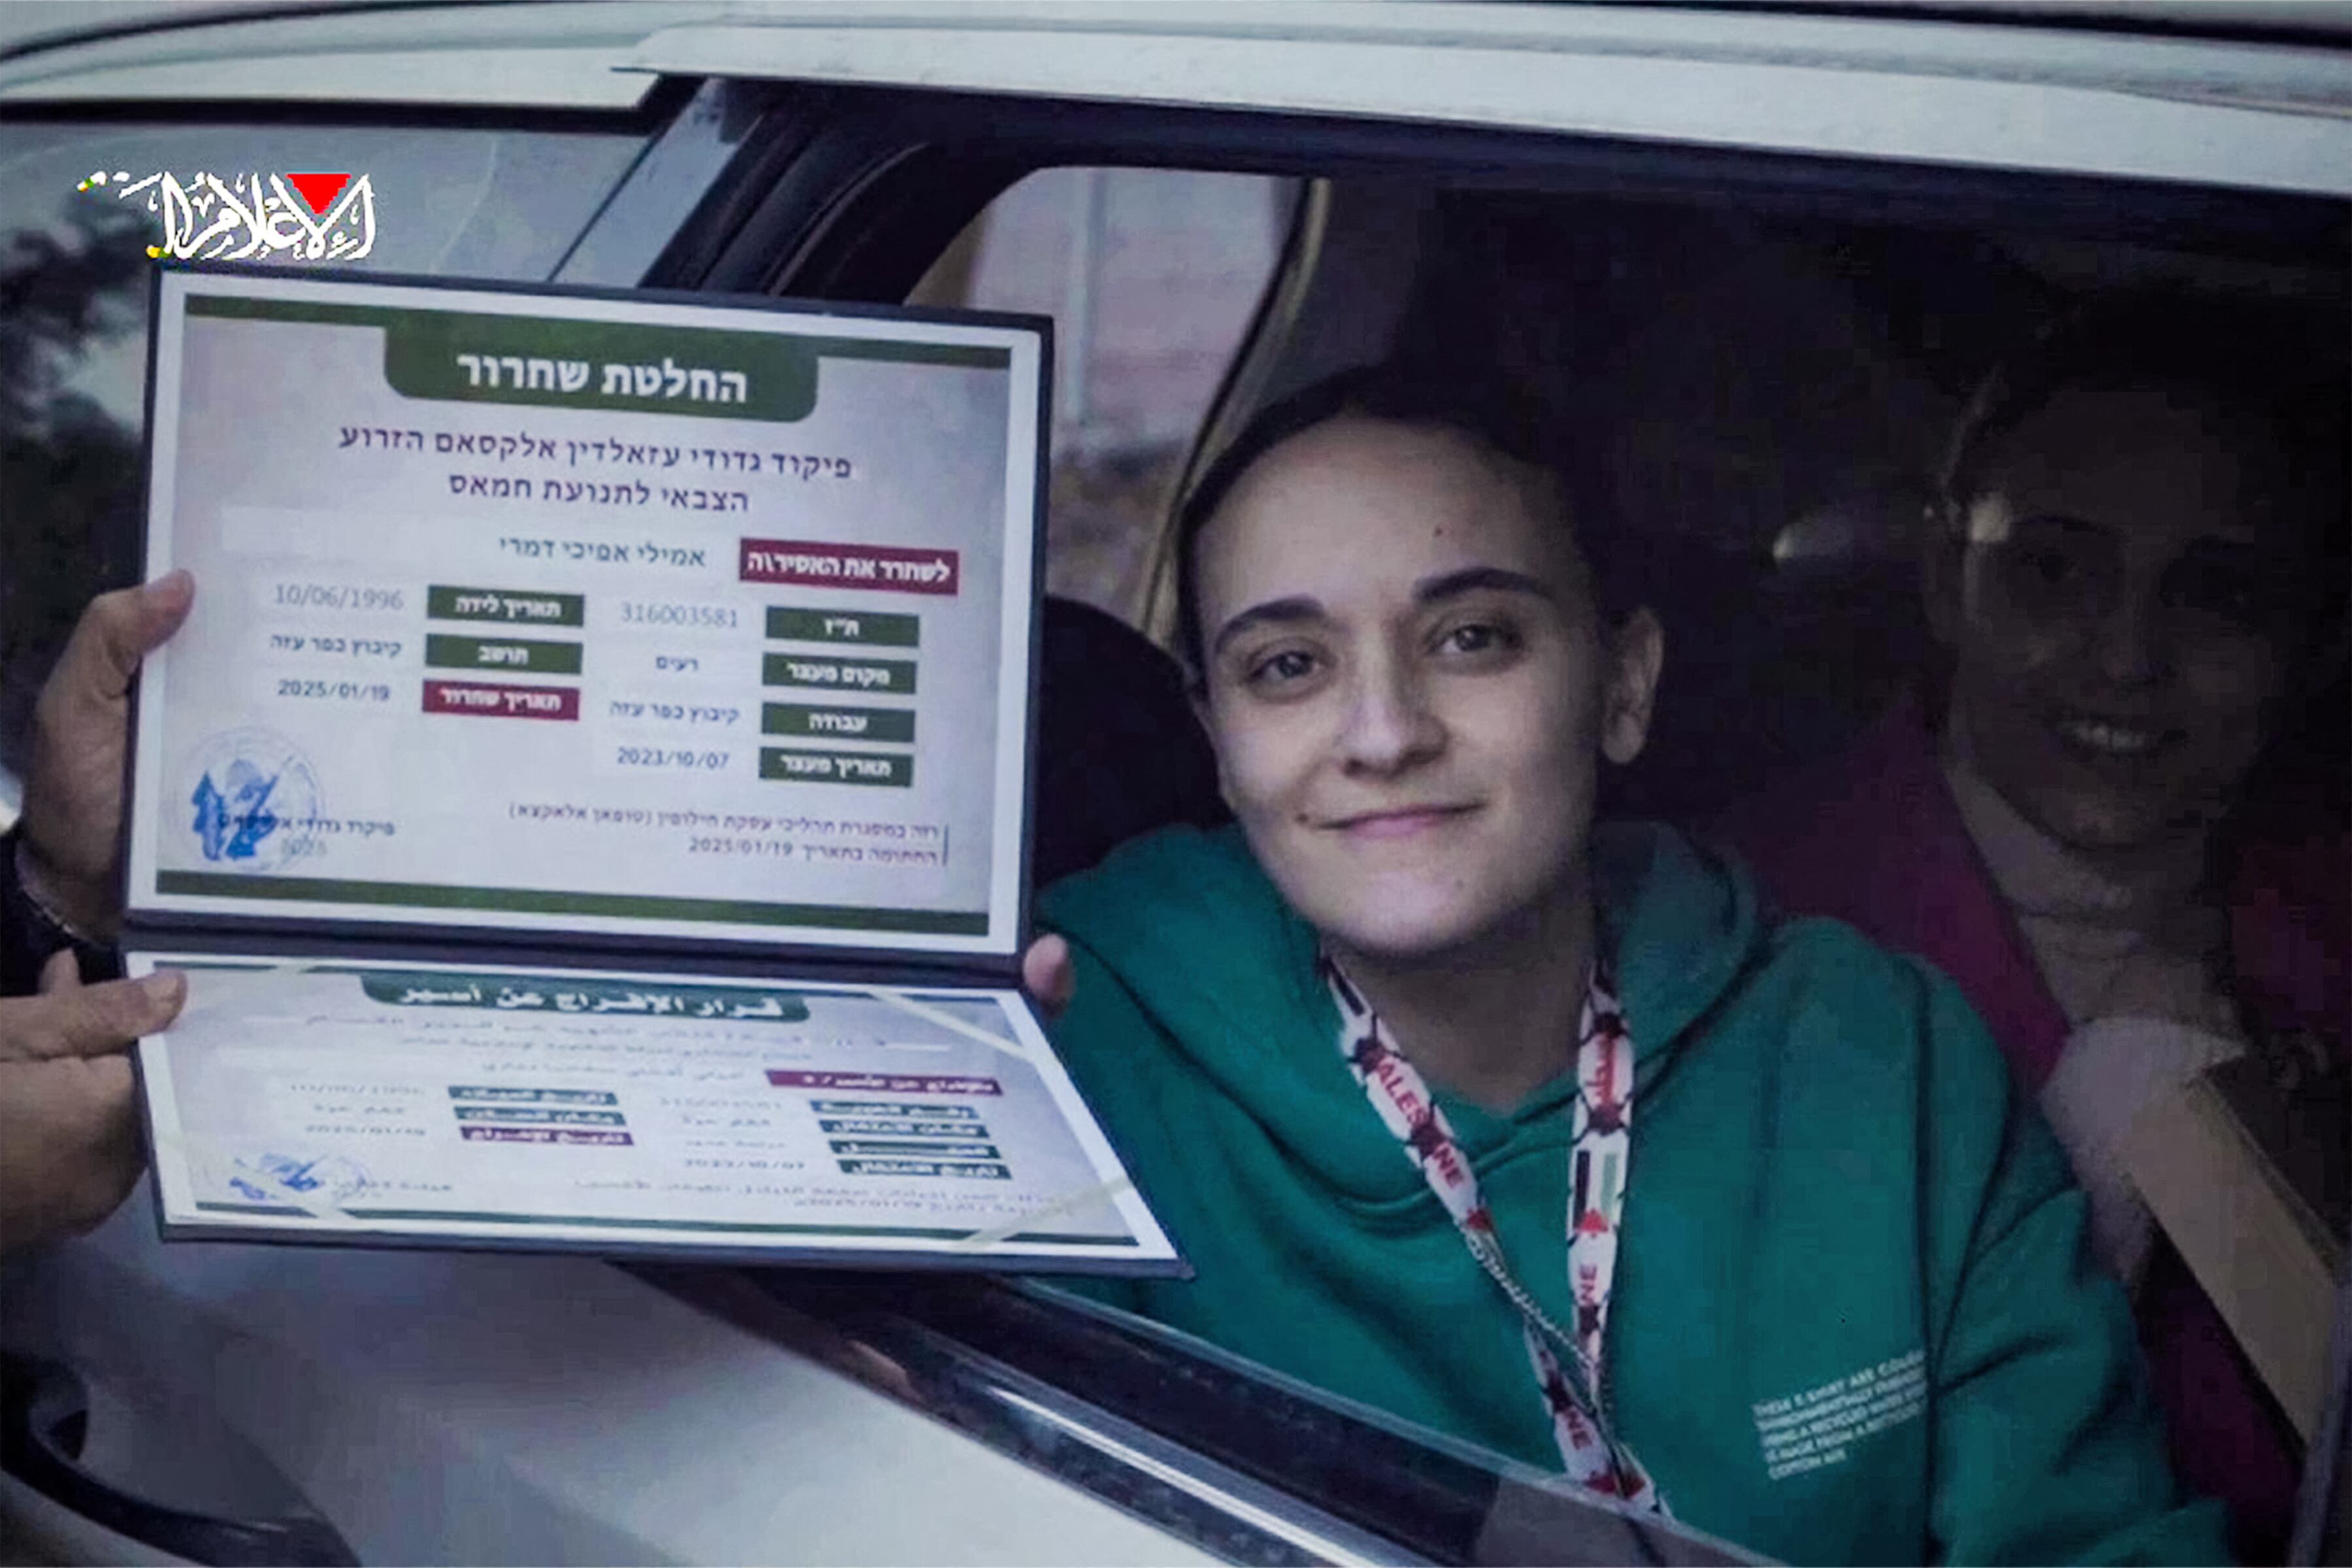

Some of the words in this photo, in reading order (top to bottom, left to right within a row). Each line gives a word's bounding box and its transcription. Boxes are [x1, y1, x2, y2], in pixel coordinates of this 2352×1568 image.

[457, 353, 588, 392] שחרור
[602, 357, 747, 403] החלטת
[338, 424, 423, 452] הזרוע
[436, 431, 557, 462] אלקסאם
[568, 438, 680, 468] עזאלדין
[691, 448, 760, 470] גדודי
[772, 453, 851, 479] פיקוד
[449, 473, 531, 498] חמאס
[543, 480, 649, 505] לתנועת
[661, 485, 748, 512] הצבאי
[499, 537, 555, 559] דמרי
[637, 543, 706, 567] אמילי
[843, 558, 875, 577] את
[275, 584, 404, 610] 10/06/1996
[455, 594, 499, 613] לידה
[504, 599, 562, 618] תאריך
[621, 601, 739, 629] 316003581
[277, 679, 391, 702] 2025/01/19
[503, 692, 562, 712] תאריך
[617, 747, 730, 770] 2023/10/07
[836, 757, 893, 779] תאריך
[689, 837, 793, 856] 2025/01/19
